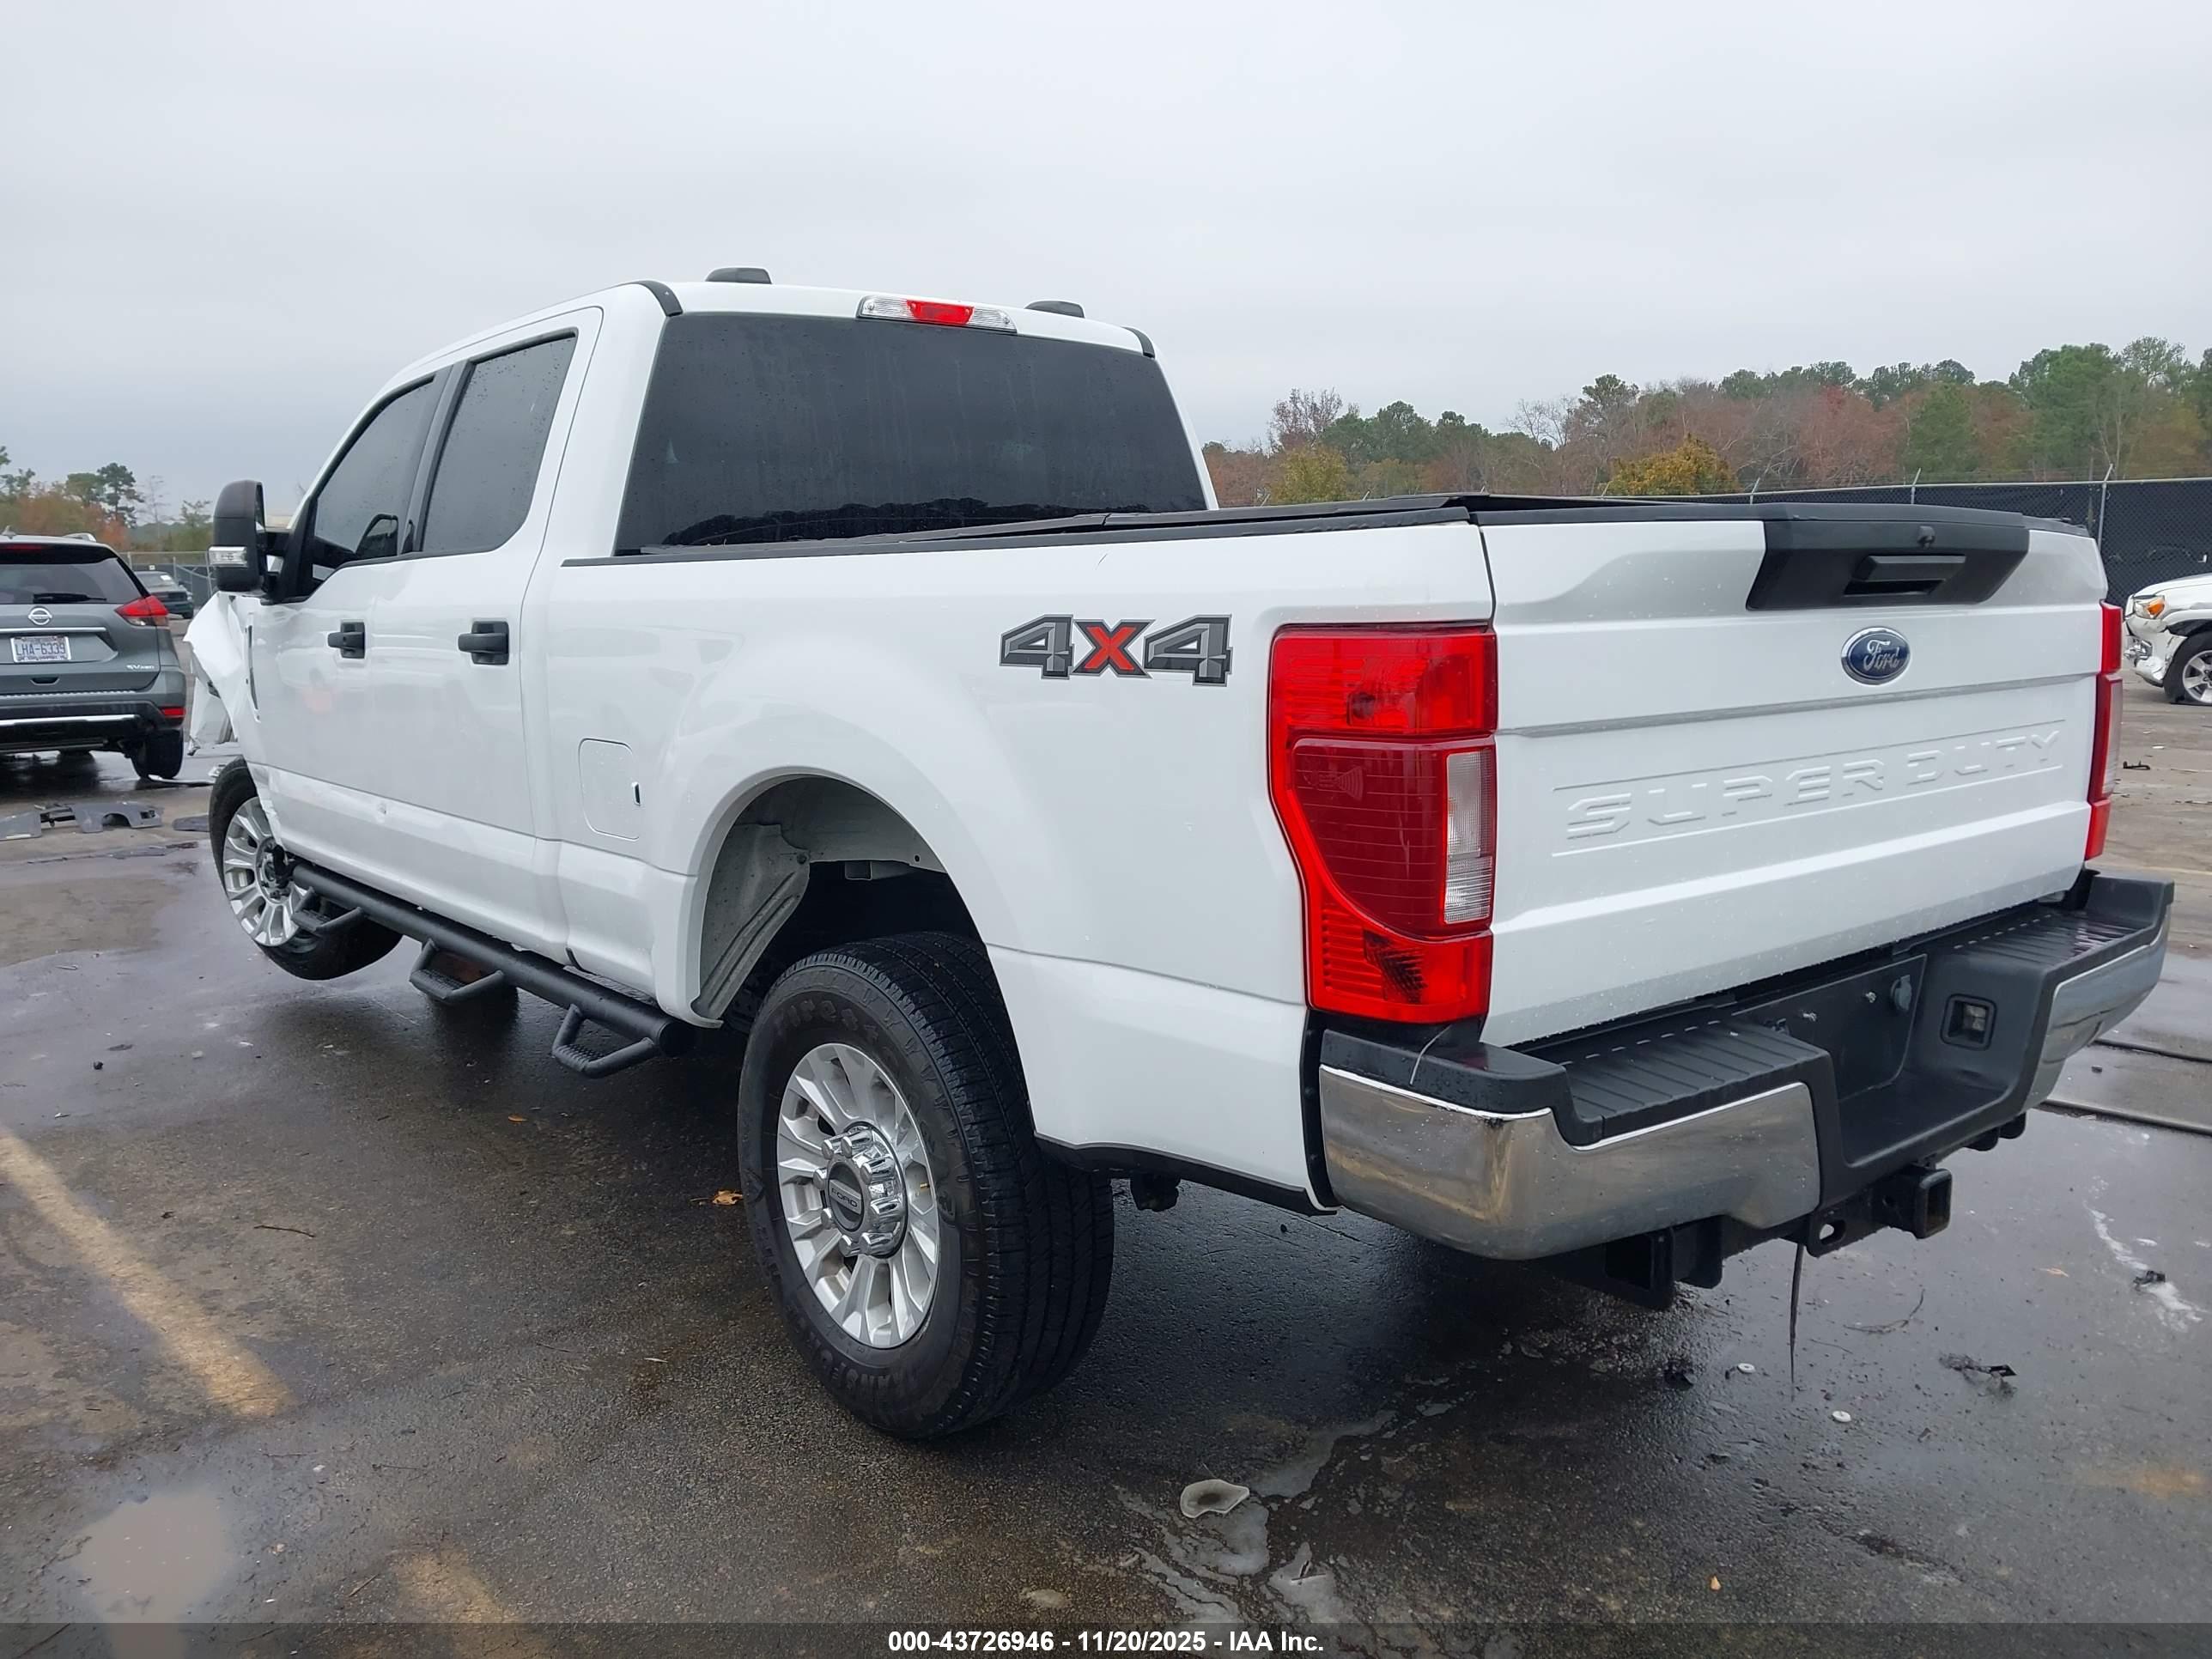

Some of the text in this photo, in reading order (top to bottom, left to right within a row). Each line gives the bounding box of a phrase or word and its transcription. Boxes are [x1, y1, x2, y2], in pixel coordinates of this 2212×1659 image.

[15, 642, 66, 656] LHA-6339
[1863, 639, 1900, 672] Ford
[1566, 729, 2061, 841] SUPER DUTY
[830, 1188, 858, 1207] FORD
